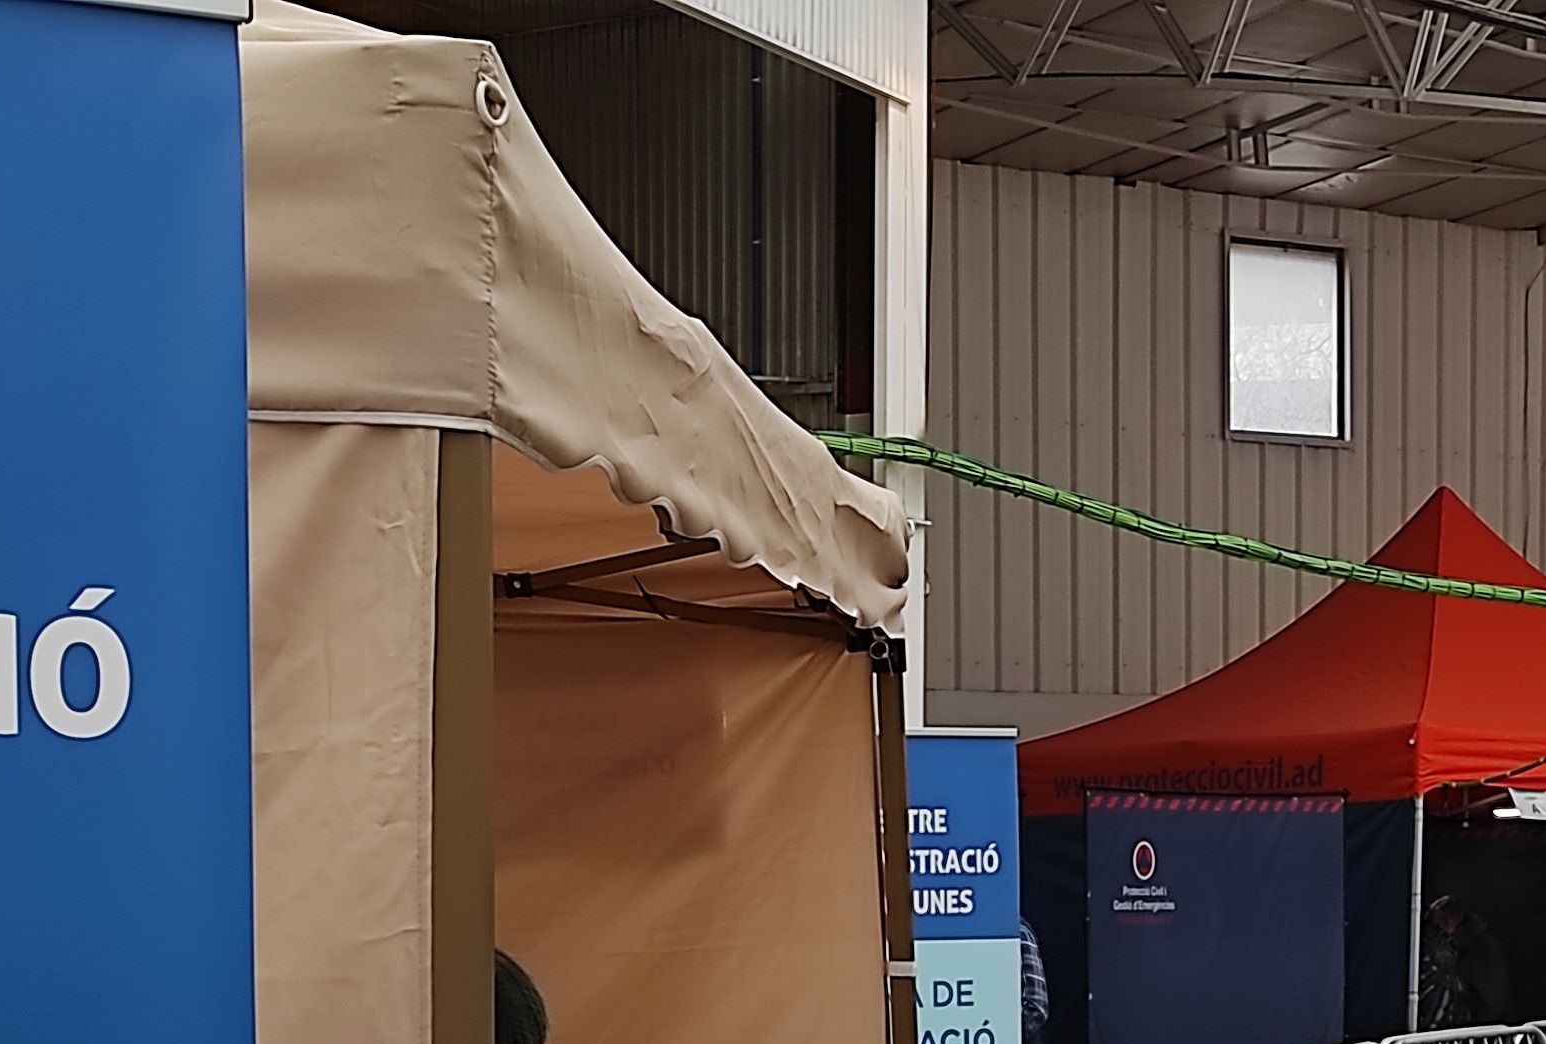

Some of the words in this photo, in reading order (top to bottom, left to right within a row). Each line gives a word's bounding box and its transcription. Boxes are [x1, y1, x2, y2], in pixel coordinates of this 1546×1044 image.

[907, 808, 947, 834] TRE
[913, 889, 974, 915] UNES
[933, 979, 974, 1007] DE
